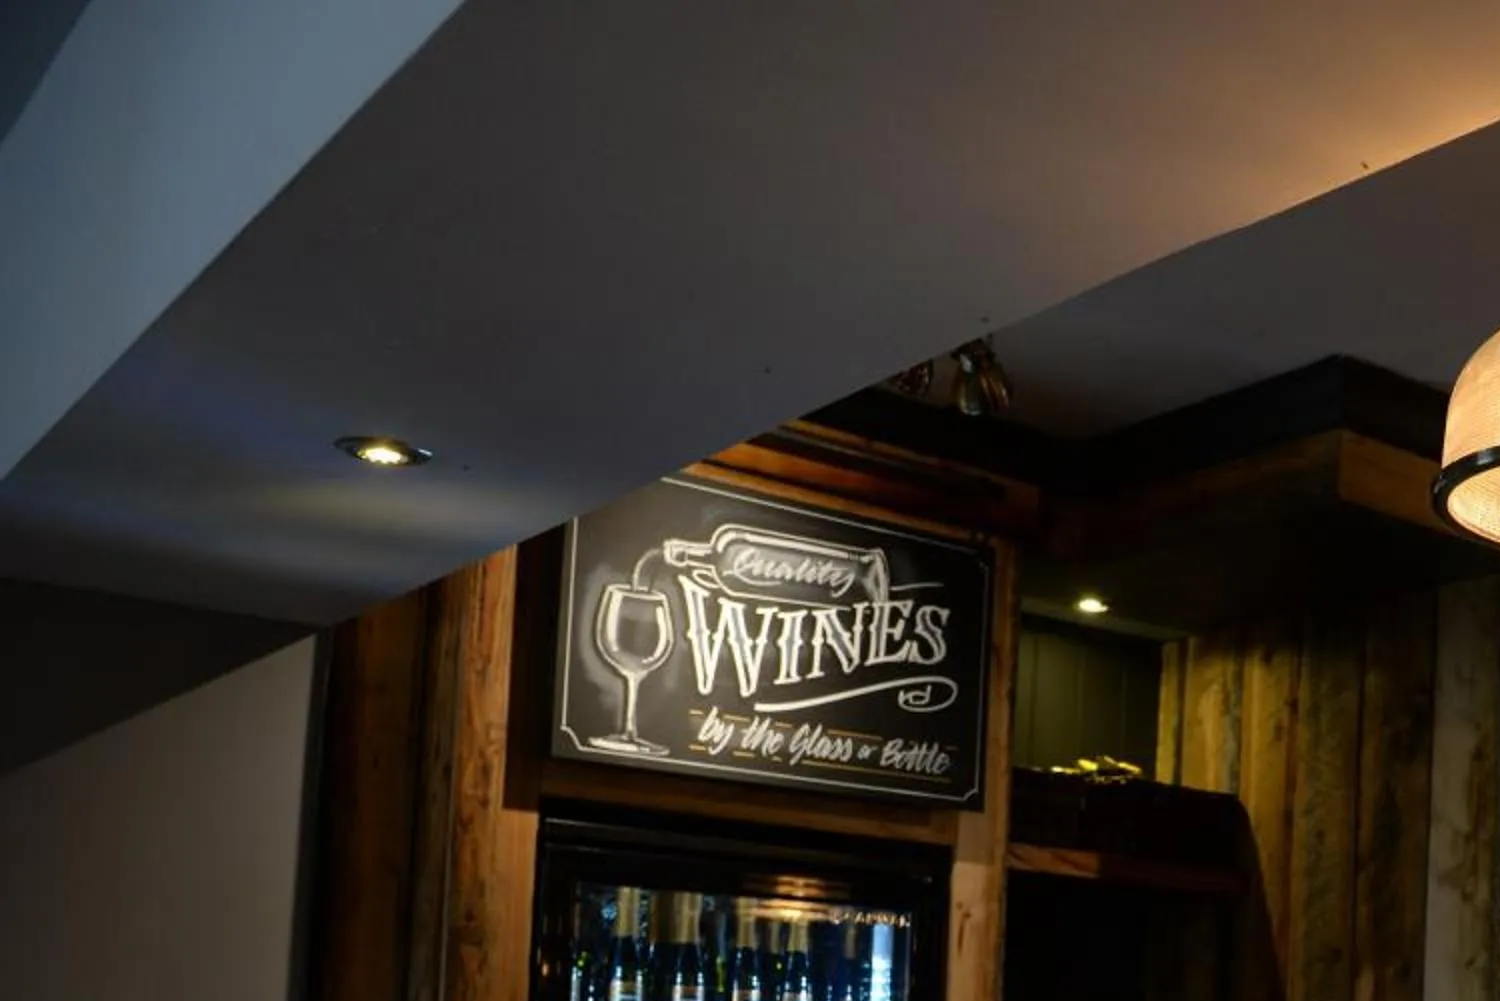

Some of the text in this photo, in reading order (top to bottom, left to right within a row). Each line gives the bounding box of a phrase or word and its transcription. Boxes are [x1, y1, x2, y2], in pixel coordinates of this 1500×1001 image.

[723, 547, 856, 595] Quality
[679, 573, 950, 698] WINES
[697, 708, 734, 754] by
[742, 716, 783, 758] the
[789, 722, 855, 765] Glass
[880, 739, 951, 775] Bottle
